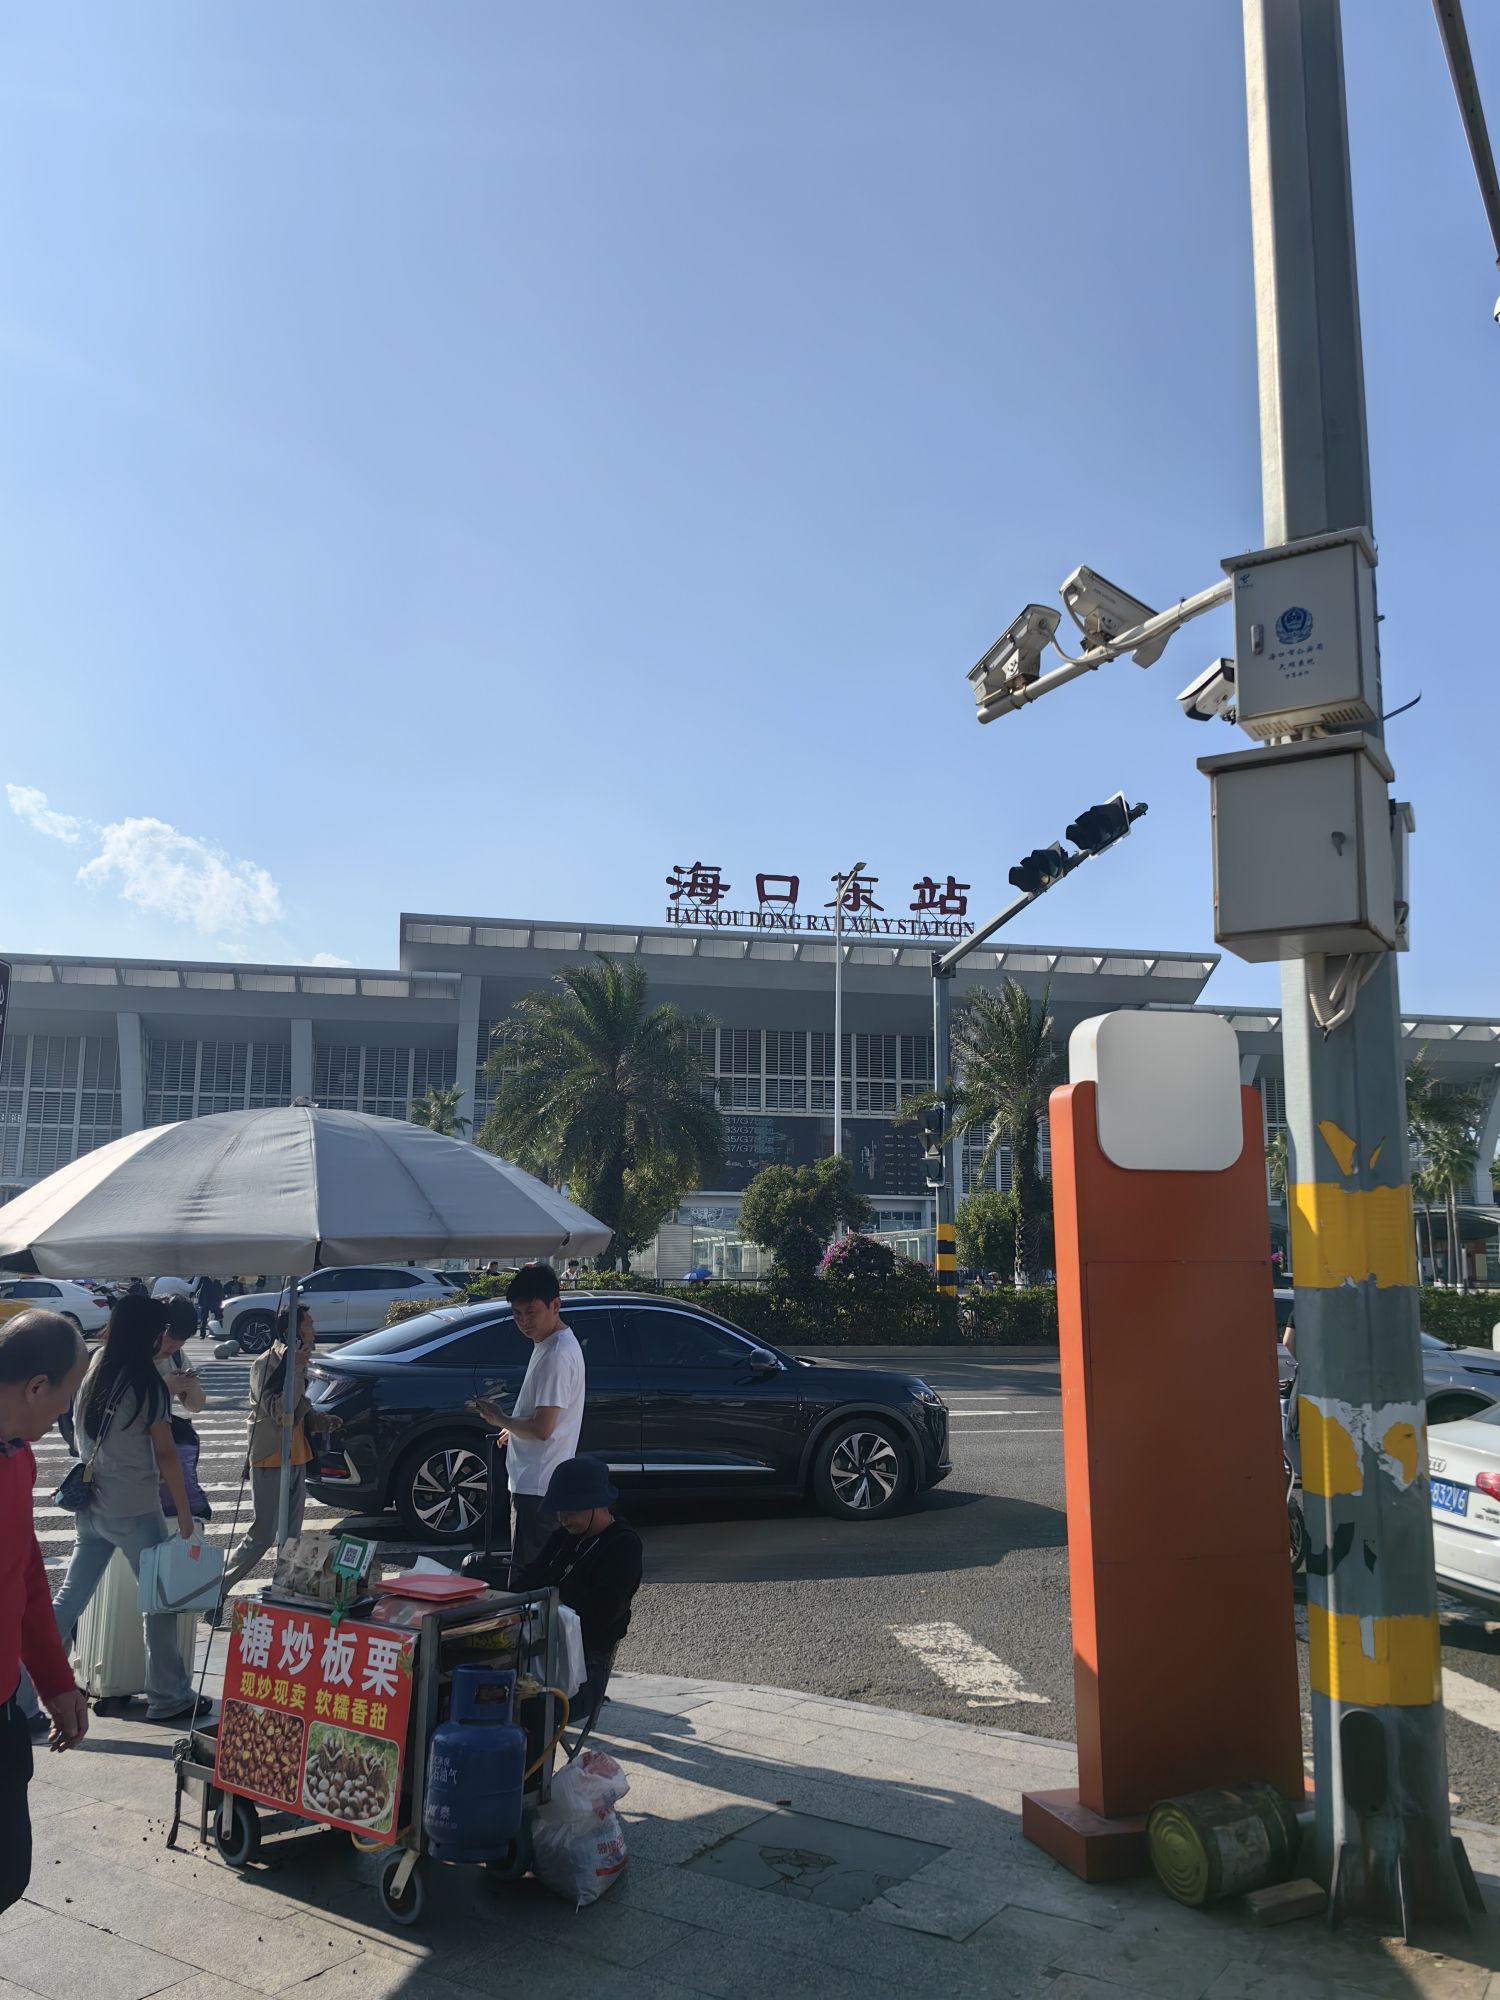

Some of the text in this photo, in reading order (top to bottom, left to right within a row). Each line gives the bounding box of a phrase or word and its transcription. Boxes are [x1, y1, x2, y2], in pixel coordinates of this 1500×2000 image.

[666, 861, 971, 916] 海口东站
[666, 907, 975, 937] HAIKOU DONG RALWAY STATION
[239, 1613, 402, 1697] 糖炒板栗
[240, 1671, 388, 1731] 现炒现卖 软糯香甜
